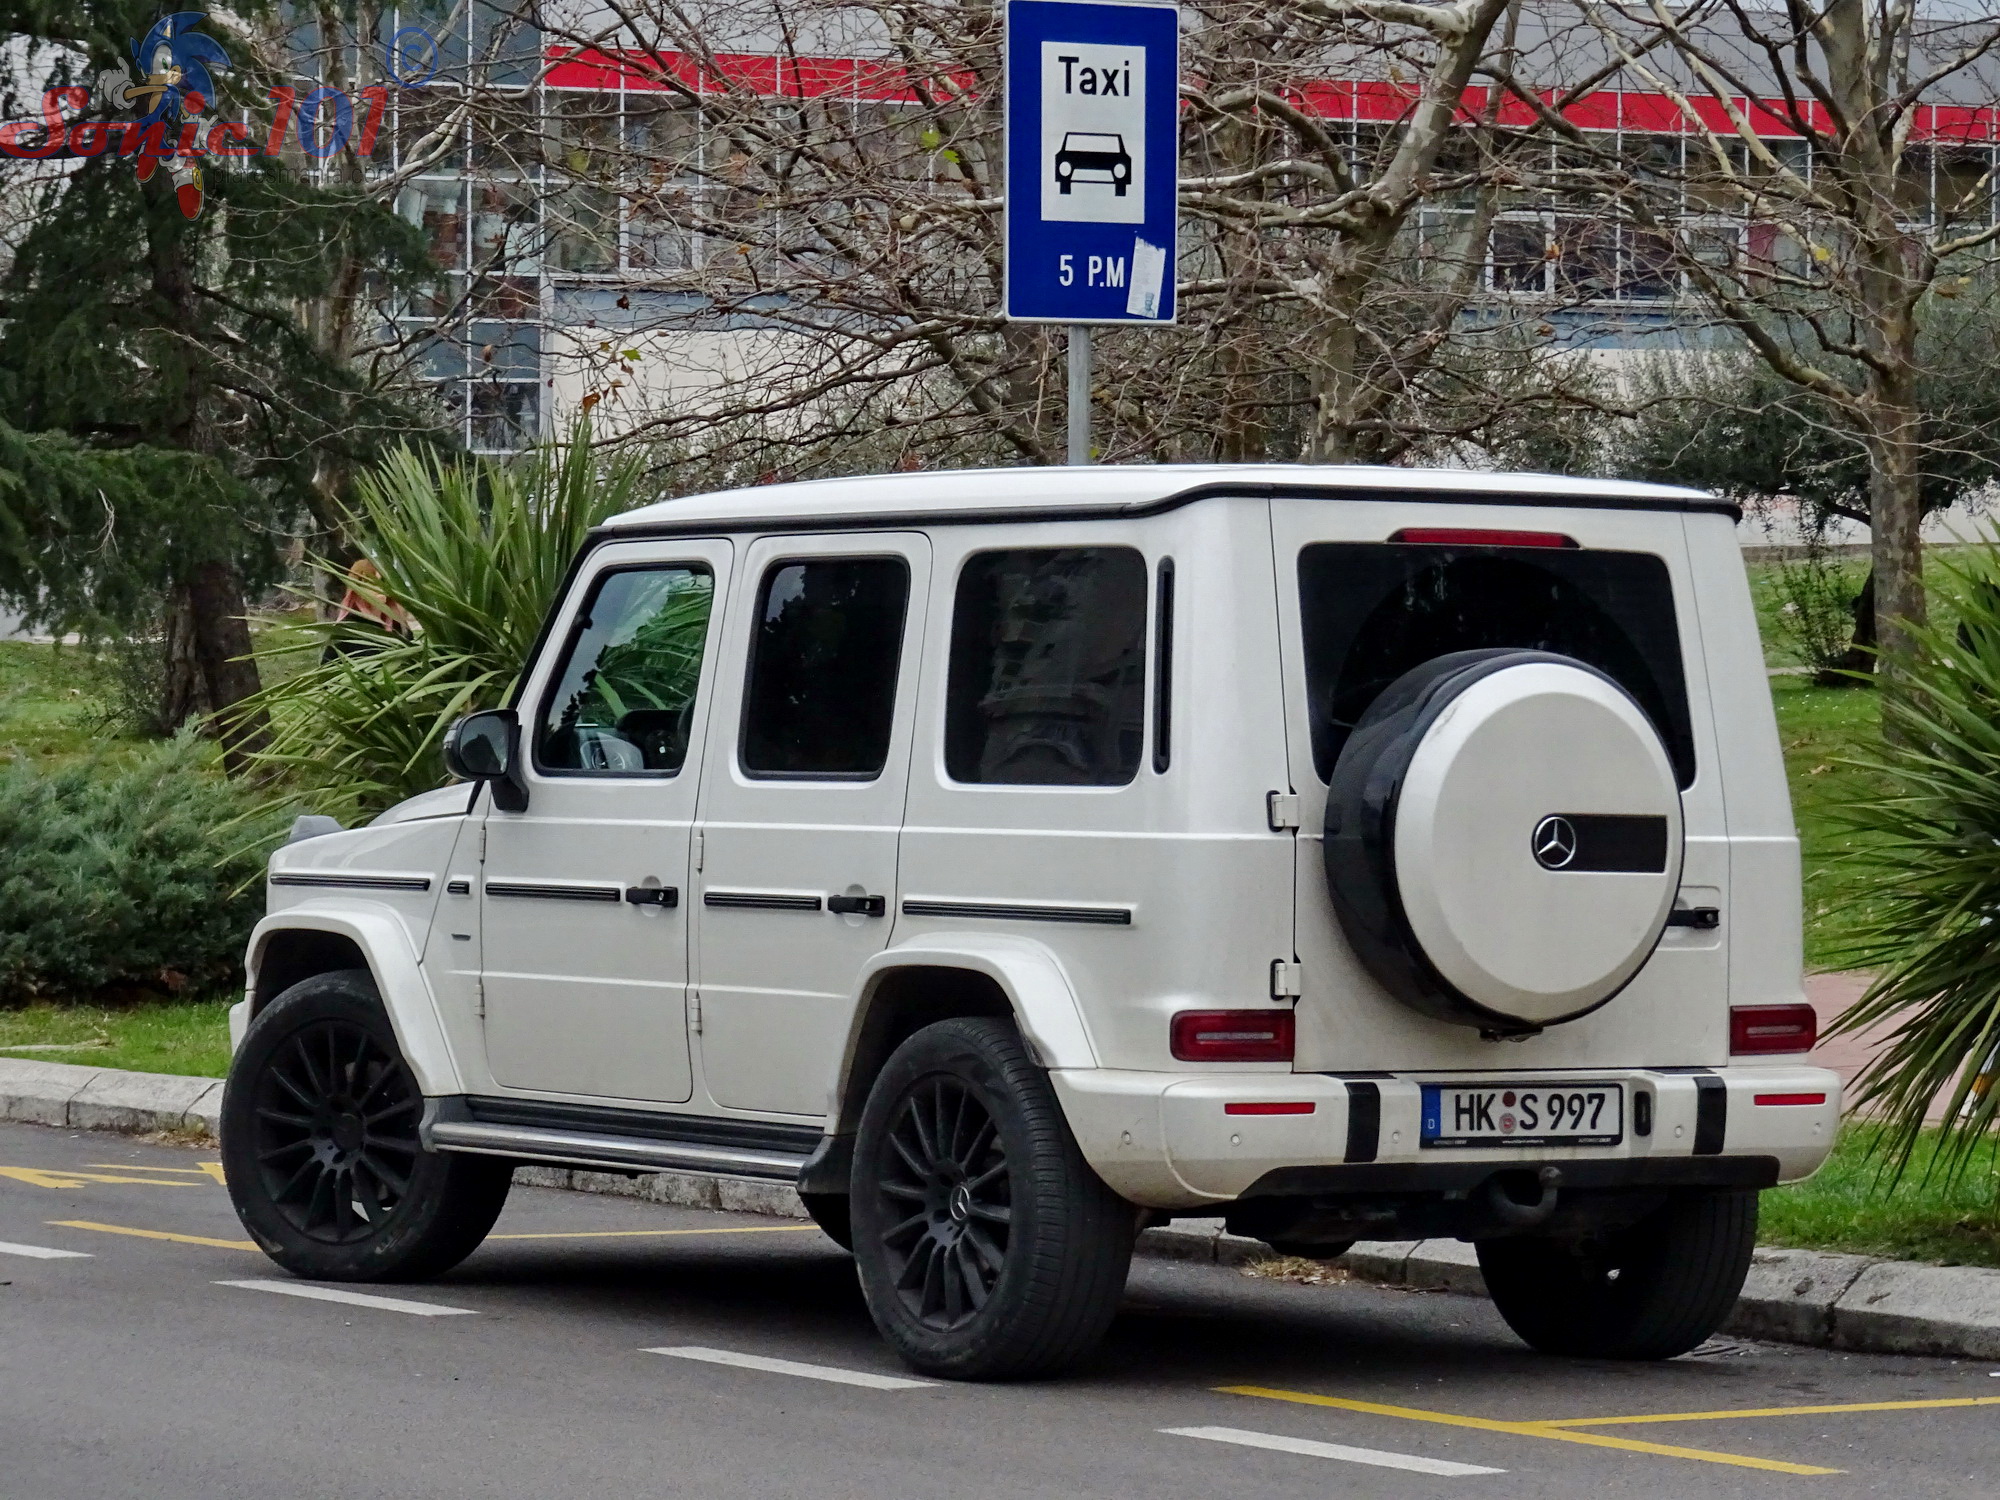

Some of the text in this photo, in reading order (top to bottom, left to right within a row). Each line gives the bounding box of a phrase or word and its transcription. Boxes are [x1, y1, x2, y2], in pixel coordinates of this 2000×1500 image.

[1058, 56, 1130, 97] Taxi
[1059, 255, 1073, 287] 5
[1427, 1118, 1436, 1130] D
[1455, 1093, 1606, 1131] HK S 997
